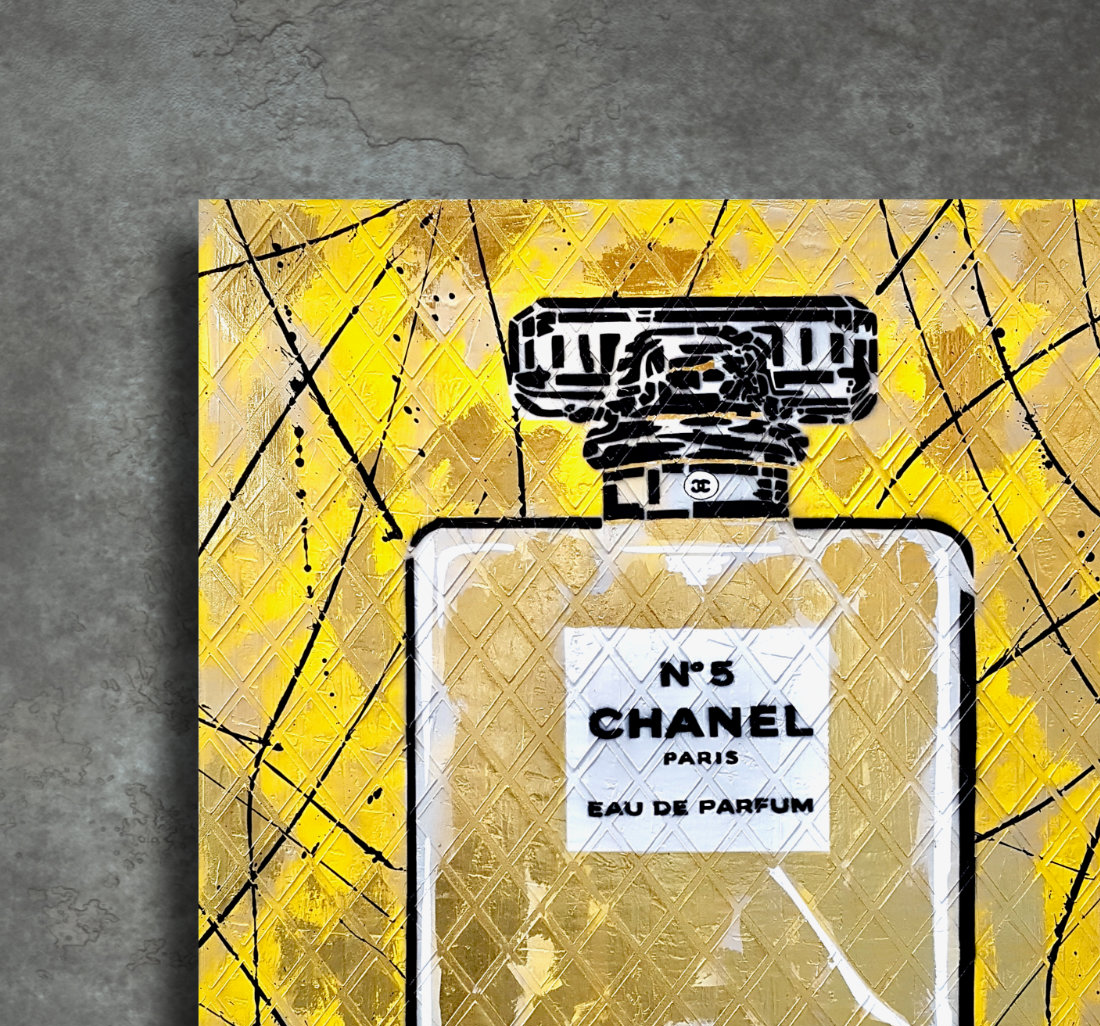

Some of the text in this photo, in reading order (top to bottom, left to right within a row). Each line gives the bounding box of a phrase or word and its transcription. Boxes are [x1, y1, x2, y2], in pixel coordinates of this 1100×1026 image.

[589, 704, 814, 740] CHANEL
[663, 750, 739, 766] PARIS
[587, 797, 814, 818] EAU DE PARFUM
